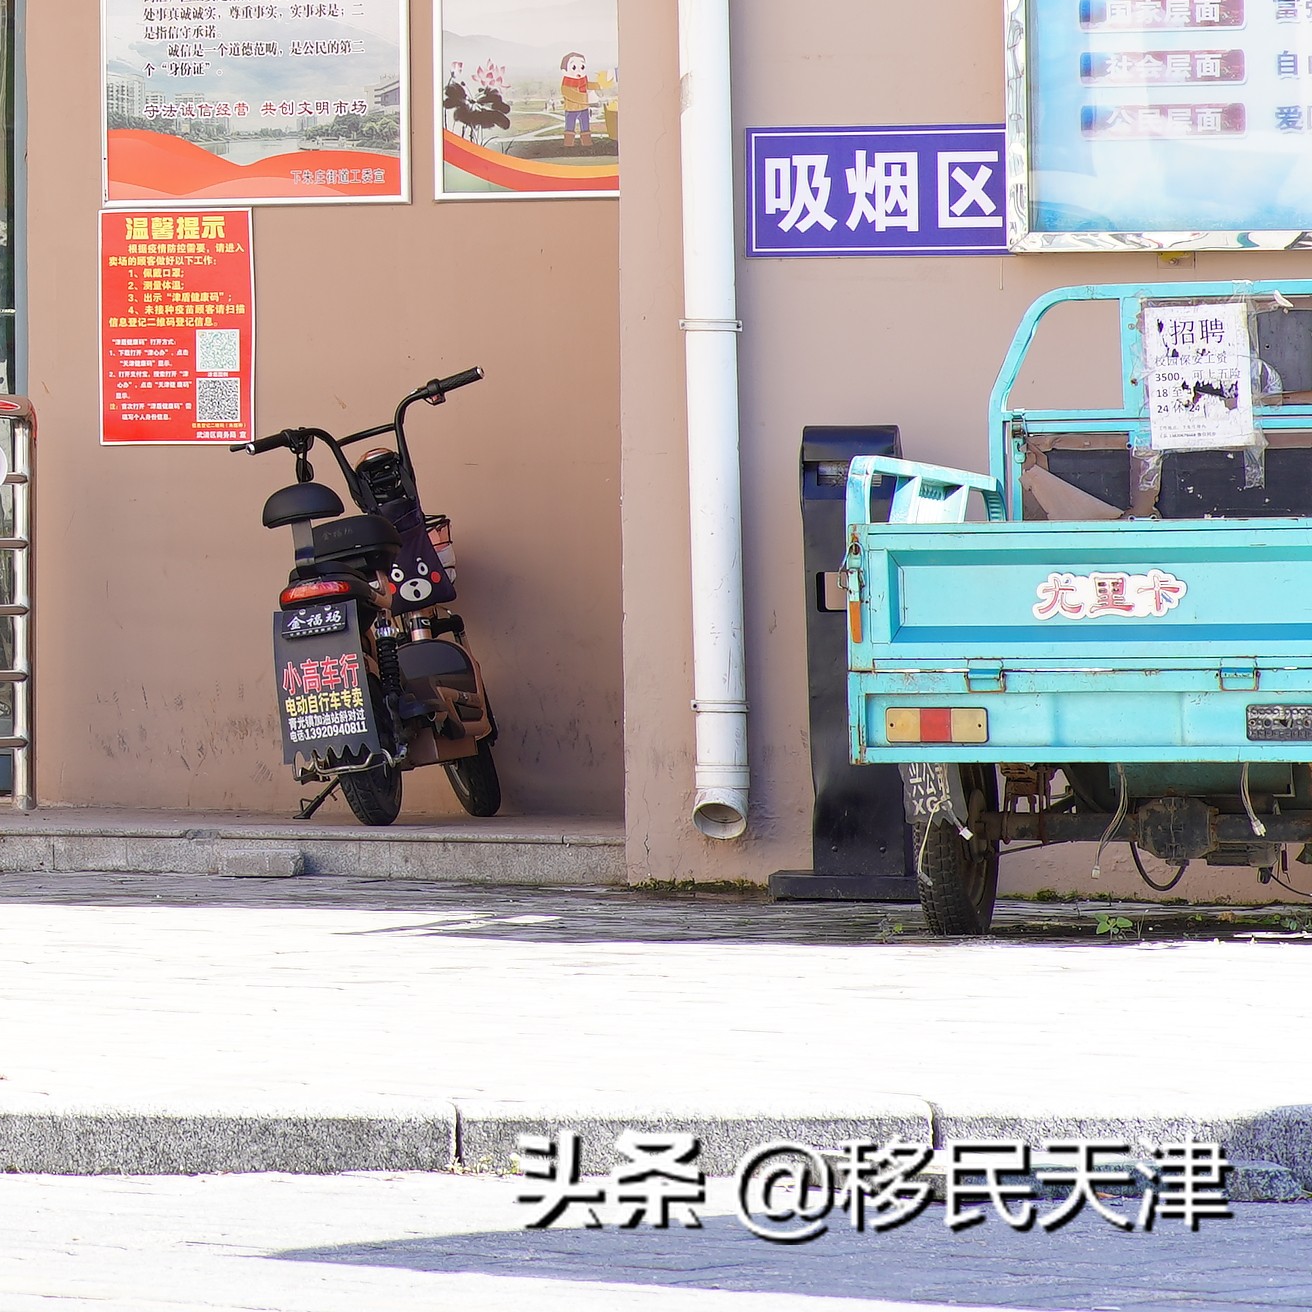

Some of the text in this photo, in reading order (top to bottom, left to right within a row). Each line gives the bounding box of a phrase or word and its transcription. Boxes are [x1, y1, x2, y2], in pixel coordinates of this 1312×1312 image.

[1106, 50, 1312, 80] 社会层面 自
[143, 99, 368, 119] 守法诚信经营 共创文明市场
[1106, 105, 1312, 133] 公民层面 爱
[763, 150, 1003, 233] 吸烟区
[125, 216, 225, 240] 温馨提示
[1170, 318, 1225, 345] 招聘
[1038, 574, 1181, 614] 尤里卡
[283, 653, 359, 696] 小高车行
[285, 688, 364, 717] 电动自行车专卖
